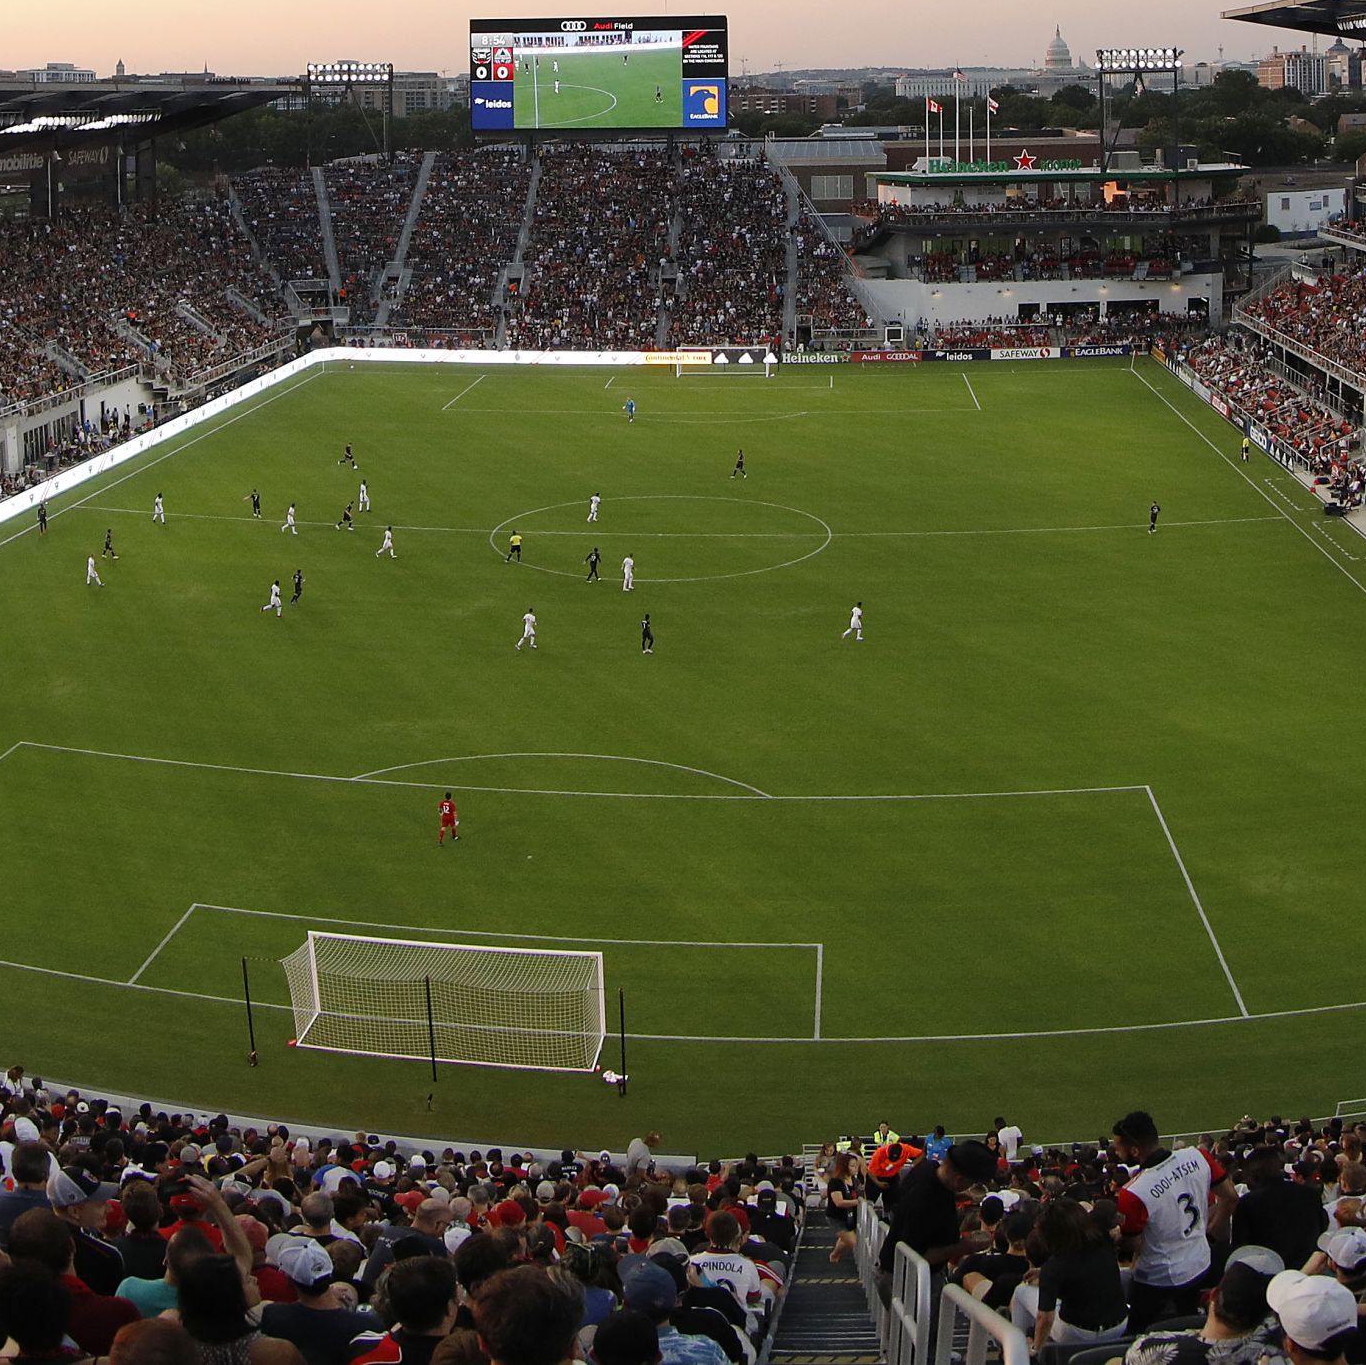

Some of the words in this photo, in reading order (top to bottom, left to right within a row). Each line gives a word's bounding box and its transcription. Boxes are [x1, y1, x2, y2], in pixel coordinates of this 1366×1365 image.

[481, 36, 506, 45] 8:54
[476, 67, 487, 79] 0
[497, 66, 508, 79] 0
[485, 100, 511, 108] leidos
[68, 150, 100, 164] SAFEWAY
[929, 158, 1009, 173] Heineken
[783, 352, 838, 363] Heineken
[947, 352, 973, 360] leidos
[1000, 350, 1039, 358] SAFEWAY
[443, 806, 450, 814] 12
[1150, 1160, 1199, 1199] ODOI-ATSEM
[1177, 1193, 1200, 1238] 3
